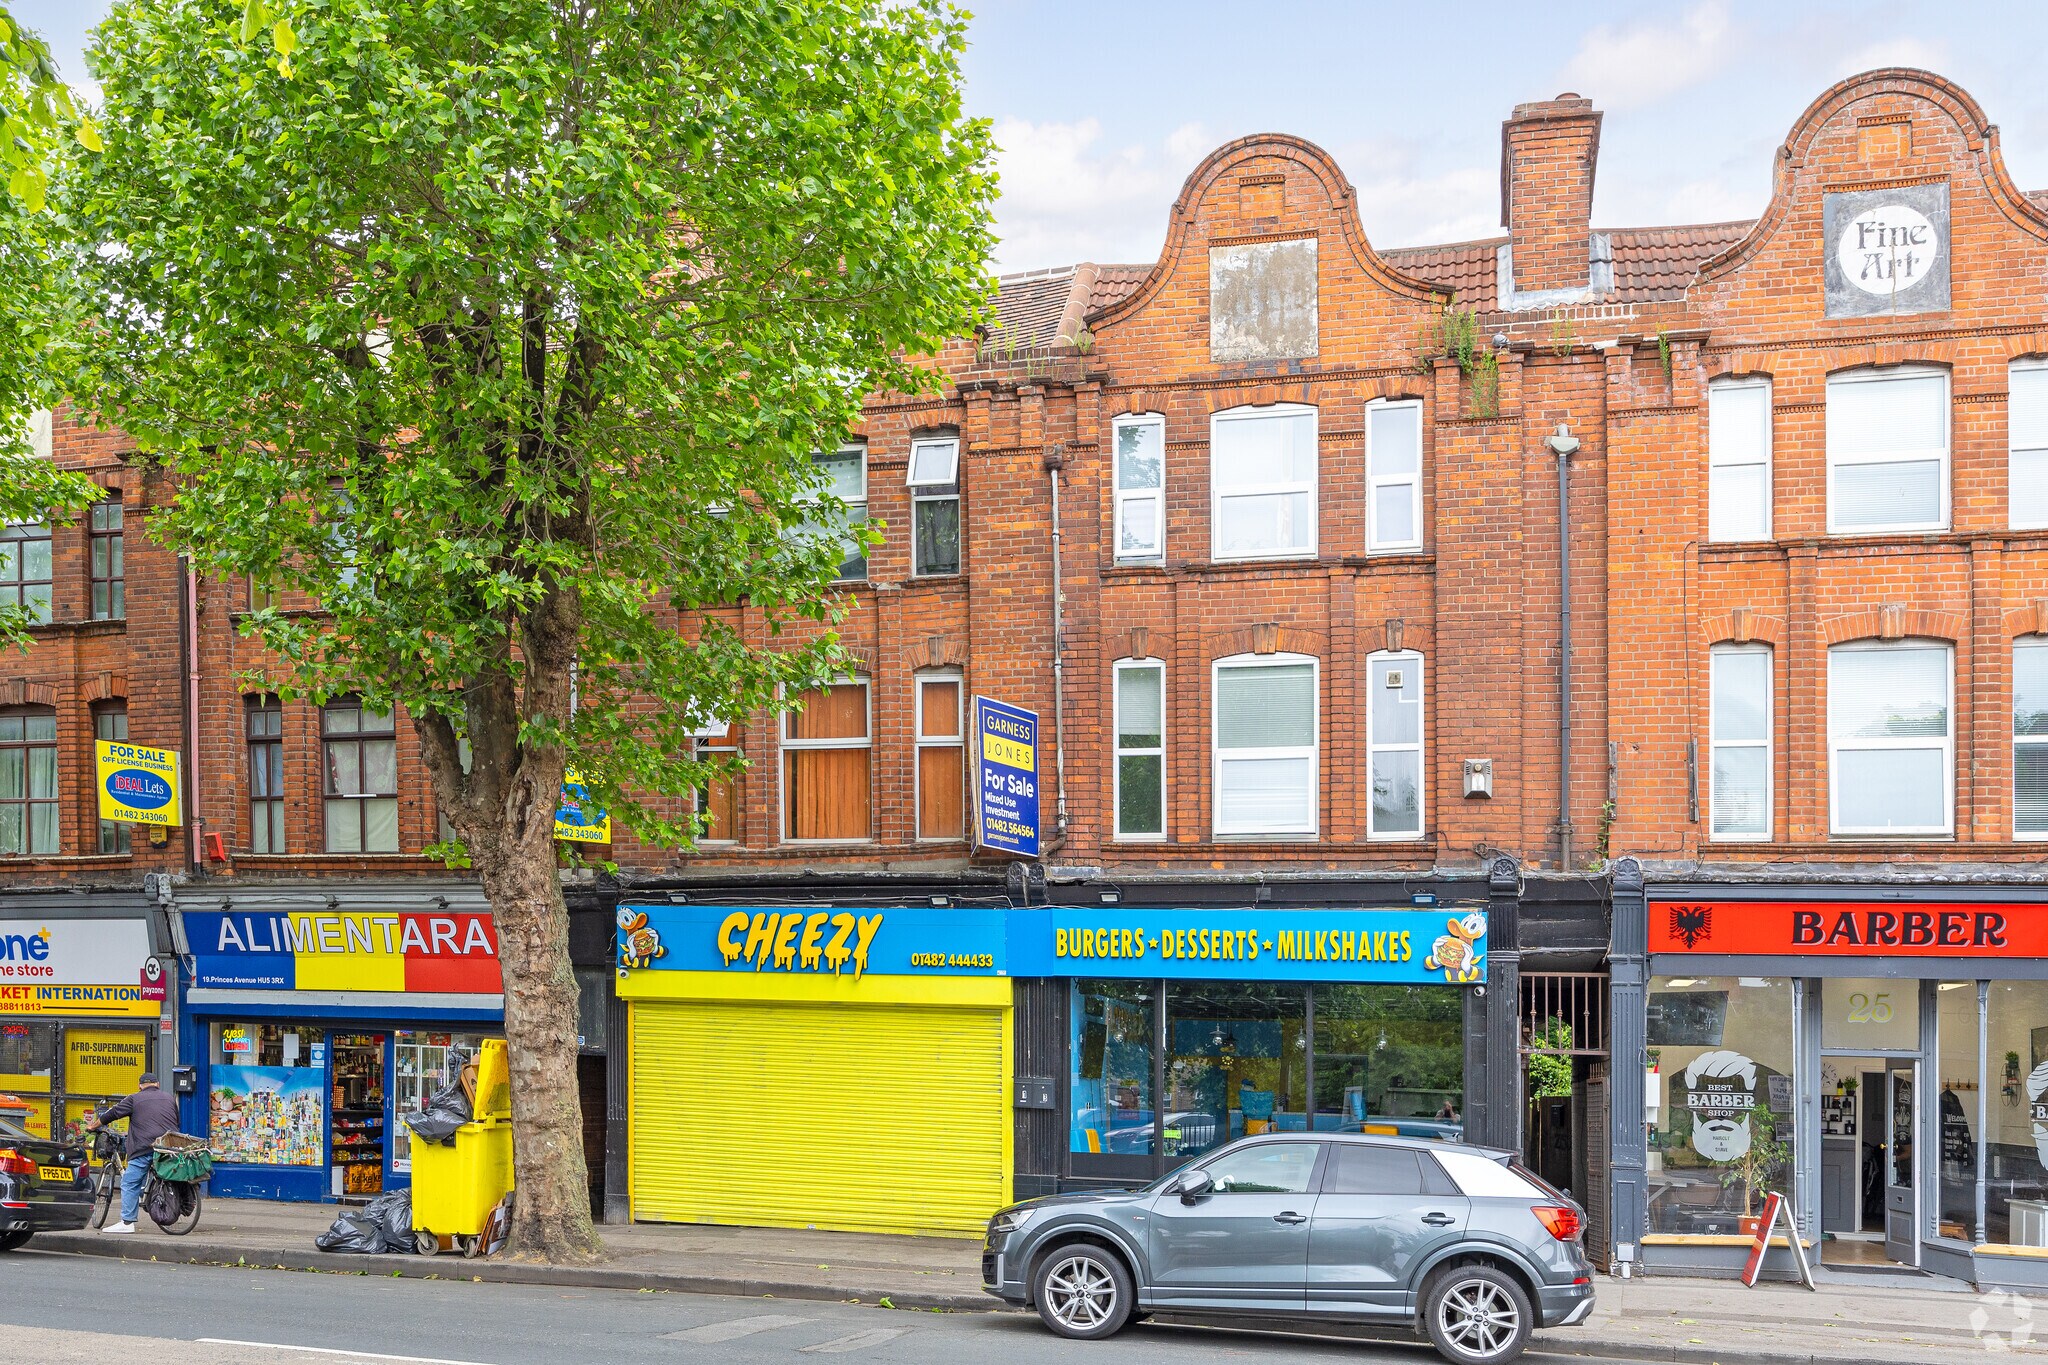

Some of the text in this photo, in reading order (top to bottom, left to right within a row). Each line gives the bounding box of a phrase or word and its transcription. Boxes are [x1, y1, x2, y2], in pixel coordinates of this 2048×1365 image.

[1856, 221, 1927, 250] Fine
[1860, 250, 1920, 280] Art
[987, 715, 1030, 741] GARNESS
[110, 745, 165, 762] FOR SALE
[988, 741, 1030, 764] JONES
[117, 758, 143, 768] LICENSE
[145, 762, 173, 771] BUSINESS
[145, 779, 164, 794] Lets
[985, 768, 1034, 798] For Sale
[985, 791, 1017, 808] Mixed Use
[114, 809, 168, 823] 01482 343060
[986, 804, 1020, 820] Investment
[576, 829, 603, 840] 343060
[986, 817, 1034, 838] 01482 564564
[217, 916, 494, 955] ALIMENTARA
[1791, 911, 2008, 948] BARBER
[717, 911, 883, 981] CHEEZY
[1055, 927, 1412, 962] BURGERS DESSERTS MILKSHAKES
[912, 952, 993, 967] 01482 444433
[17, 964, 53, 976] store
[0, 987, 31, 999] KET
[142, 987, 164, 996] payzone
[1848, 993, 1894, 1023] 25
[225, 1042, 249, 1051] OPEN
[80, 1055, 138, 1066] INTERNATIONAL
[1687, 1094, 1755, 1107] BARBER
[1708, 1109, 1734, 1117] SHOP
[2036, 1106, 2048, 1119] B
[43, 1168, 59, 1178] FP65
